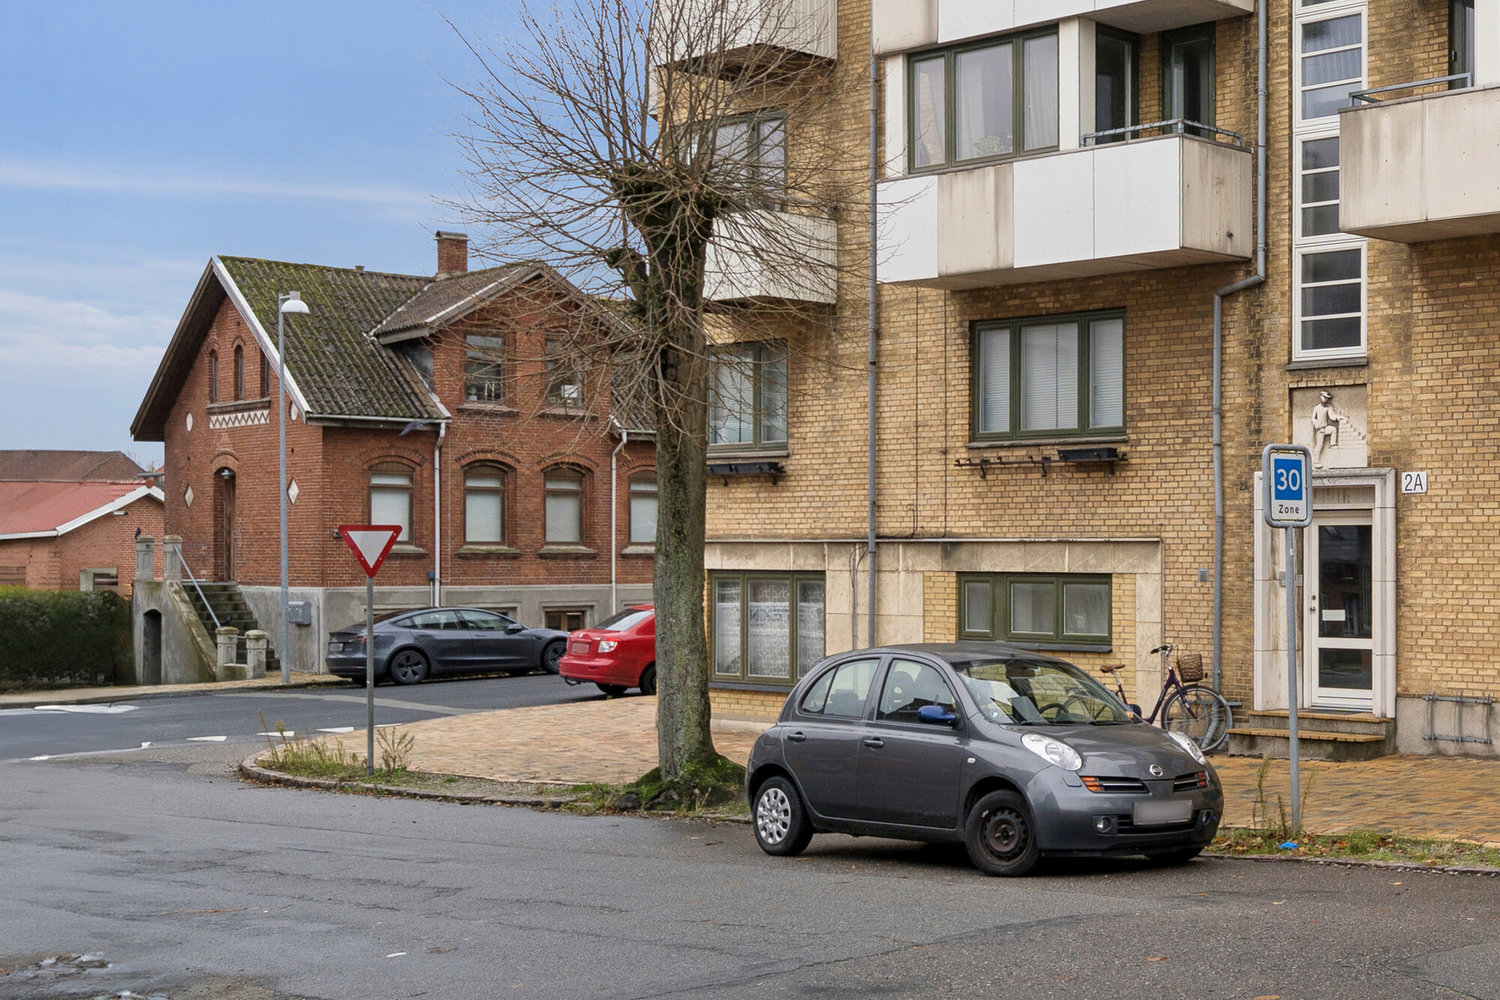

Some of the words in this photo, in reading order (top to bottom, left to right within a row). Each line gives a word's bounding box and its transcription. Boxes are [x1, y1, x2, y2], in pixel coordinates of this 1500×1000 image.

[1277, 468, 1300, 490] 30
[1404, 473, 1424, 491] 2A
[1278, 504, 1300, 514] Zone
